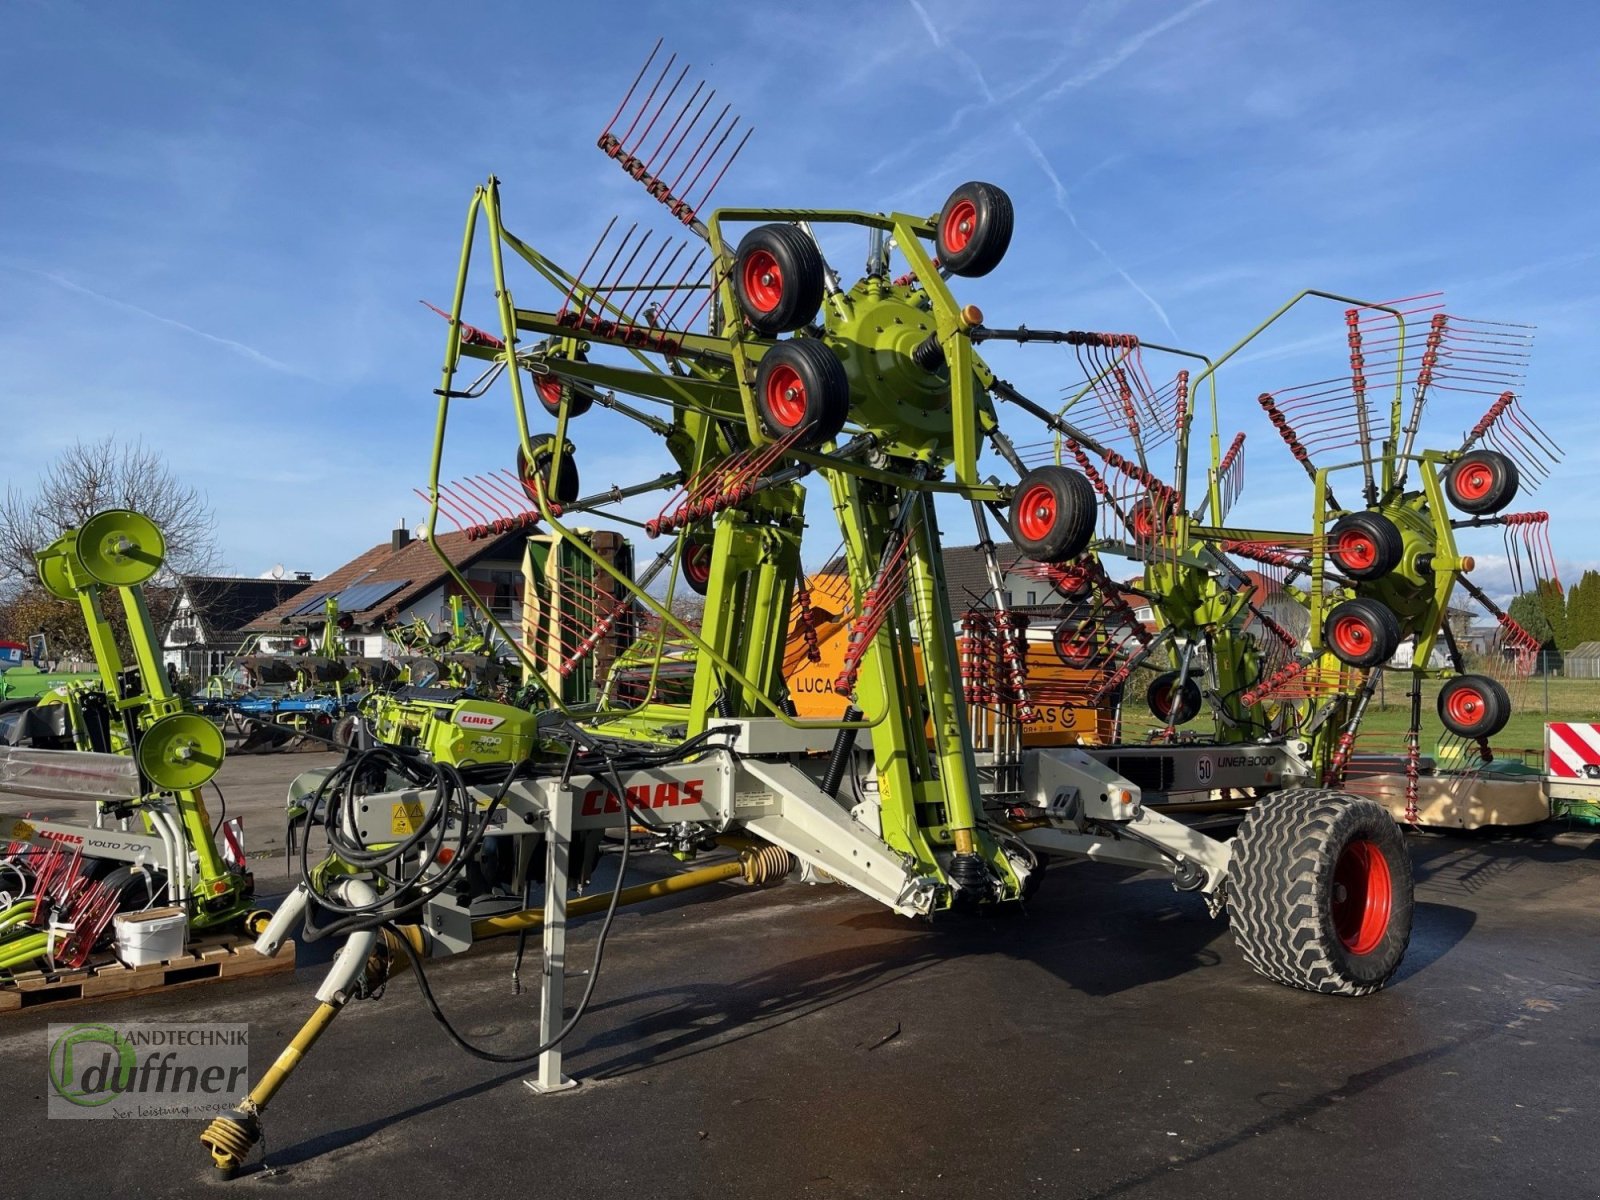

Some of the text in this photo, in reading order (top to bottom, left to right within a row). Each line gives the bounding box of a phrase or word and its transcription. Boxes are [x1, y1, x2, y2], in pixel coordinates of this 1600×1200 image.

[797, 678, 833, 693] LUCA
[462, 716, 494, 725] CLAAS
[1218, 756, 1275, 767] LINER 3000
[1199, 760, 1211, 779] 50
[581, 780, 704, 816] CLAAS
[39, 831, 84, 844] CLAAS
[87, 839, 121, 850] VOLTO
